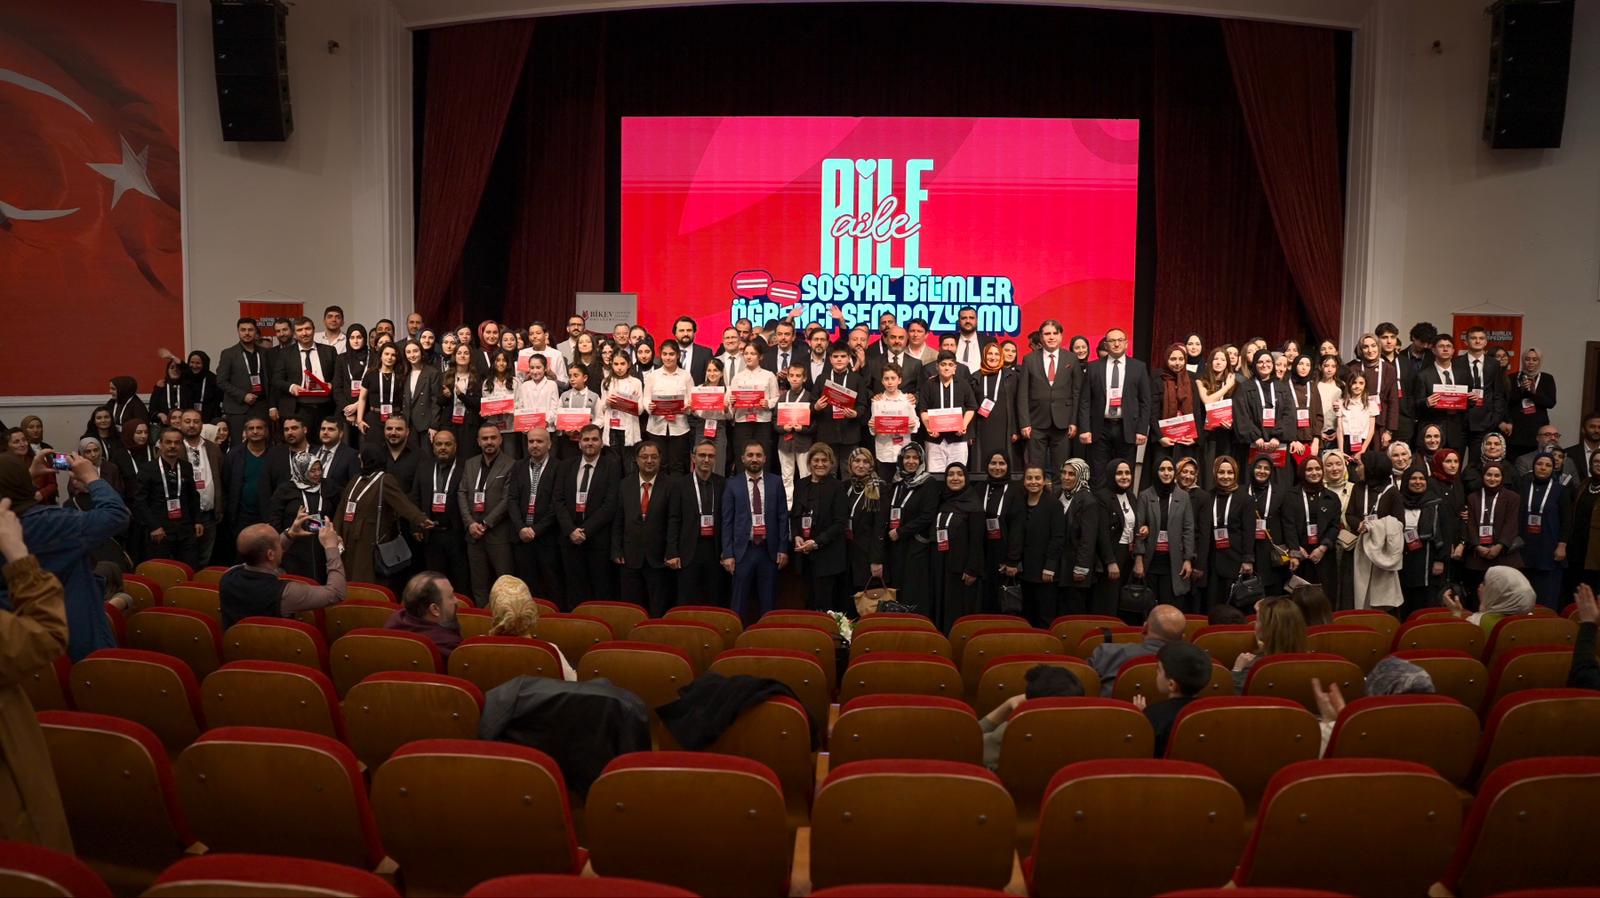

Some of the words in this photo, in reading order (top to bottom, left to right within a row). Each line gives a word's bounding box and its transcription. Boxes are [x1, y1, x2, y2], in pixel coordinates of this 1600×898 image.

[831, 194, 922, 242] aile
[802, 275, 895, 301] SOSYAL
[904, 276, 1011, 302] BİLİMLER
[842, 303, 1019, 332] SEMPOZYMU
